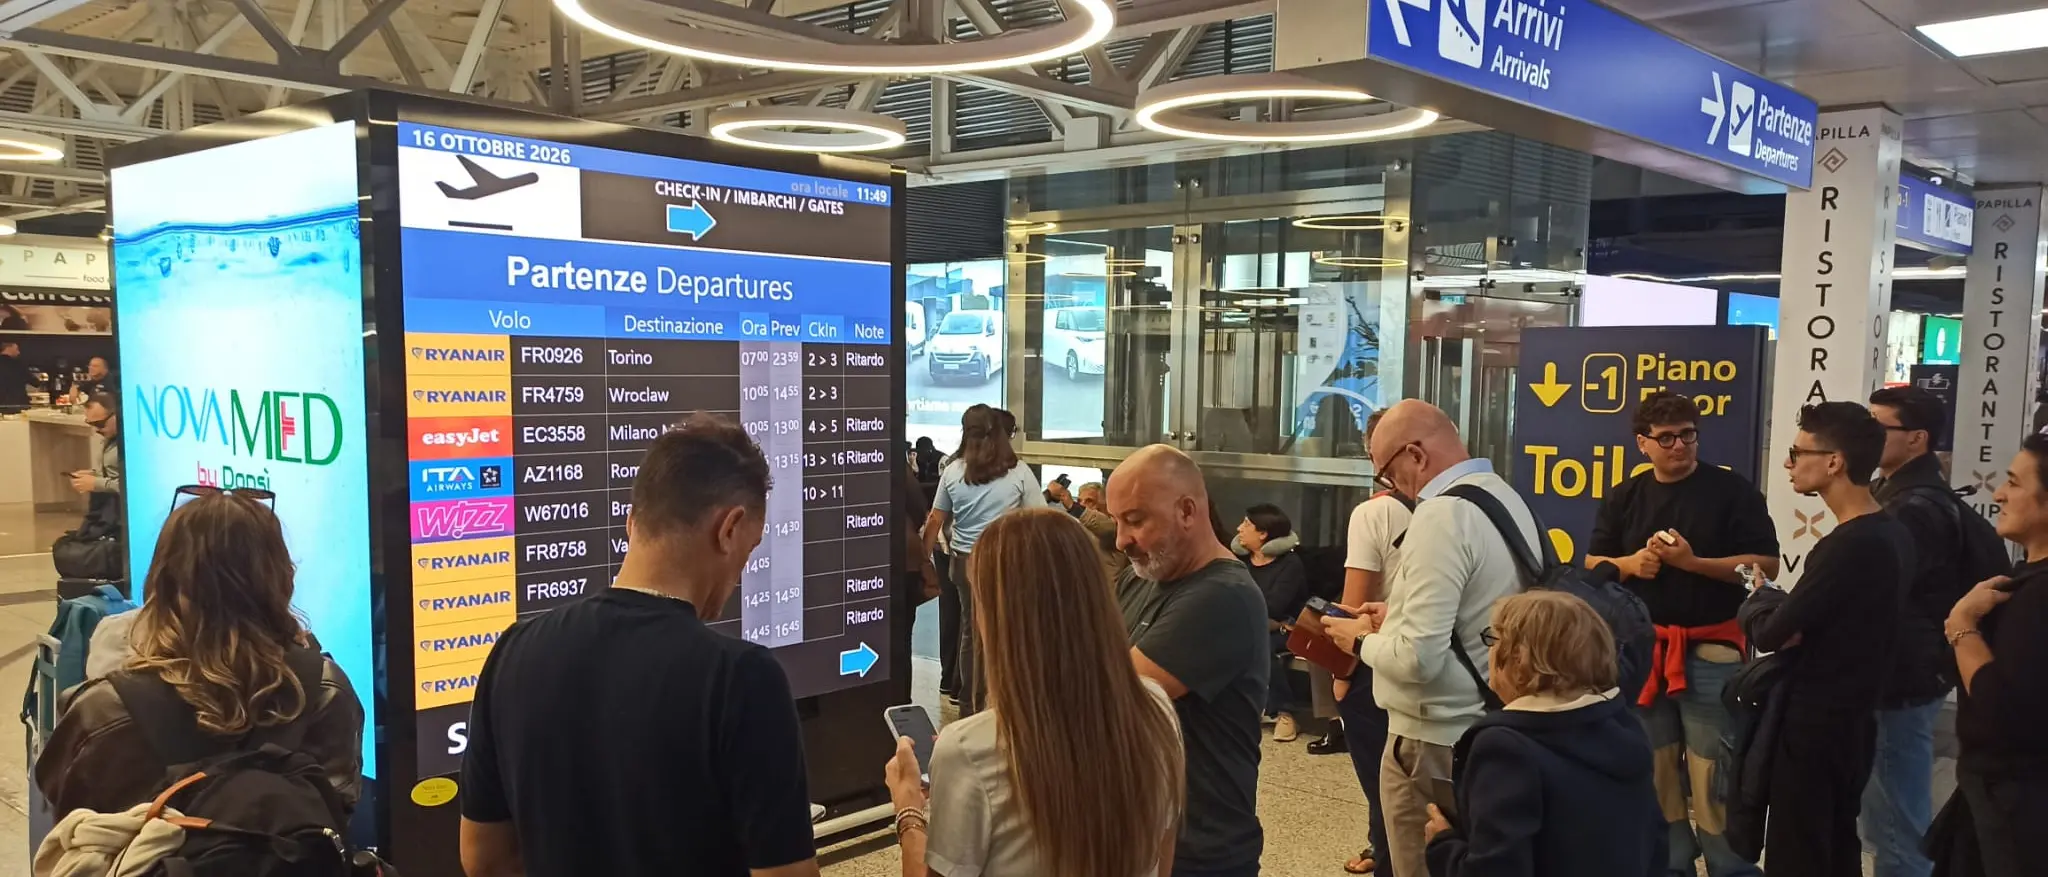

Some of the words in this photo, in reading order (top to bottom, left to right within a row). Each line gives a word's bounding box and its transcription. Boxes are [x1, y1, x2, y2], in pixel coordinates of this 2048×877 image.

[1493, 0, 1565, 51] Arrivi
[1490, 45, 1551, 90] Arrivals
[1757, 94, 1812, 147] Partenze
[1815, 125, 1870, 140] PILLA
[413, 129, 435, 147] 16
[440, 133, 525, 159] OTTOBRE
[530, 145, 571, 164] 2026
[1754, 138, 1799, 172] Departures
[655, 180, 721, 202] CHECK-IN
[734, 190, 797, 211] IMBARCHI
[808, 199, 844, 215] GATES
[791, 181, 810, 194] ora
[814, 180, 849, 199] locale
[856, 187, 888, 203] 11:49
[1977, 198, 2033, 210] PAPILLA
[23, 249, 96, 265] PAP
[507, 255, 647, 293] Partenze
[657, 266, 793, 303] Departures
[1806, 186, 1839, 402] RISTORA
[1871, 186, 1891, 394] RISTORA
[489, 309, 531, 329] Volo
[624, 315, 724, 335] Destinazione
[742, 320, 767, 337] Ora
[771, 320, 800, 337] Prev
[854, 324, 885, 340] Note
[425, 349, 505, 361] RYANAIR
[521, 346, 583, 364] FR0926
[608, 349, 653, 365] Torino
[808, 353, 816, 366] 2
[830, 353, 838, 366] 3
[846, 352, 884, 366] Ritardo
[1636, 352, 1737, 381] Piano
[1979, 242, 2009, 463] RISTORANTE
[427, 390, 506, 403] RYANAIR
[522, 387, 584, 404] FR4759
[608, 386, 669, 403] Wroclaw
[808, 386, 816, 400] 2
[830, 386, 838, 400] 3
[1586, 366, 1618, 400] -1
[422, 428, 500, 447] easyJet
[523, 425, 586, 443] EC3558
[610, 425, 658, 440] Milano
[808, 420, 816, 433] 4
[830, 420, 838, 433] 5
[846, 417, 884, 432] Ritardo
[197, 461, 217, 488] by
[422, 466, 476, 483] ITA
[524, 464, 584, 483] AZ1168
[803, 453, 816, 467] 13
[831, 452, 845, 466] 16
[846, 449, 884, 464] Ritardo
[1524, 445, 1732, 498] Toil
[427, 482, 473, 492] AIRWAYS
[524, 502, 589, 522] W67016
[803, 487, 817, 501] 10
[831, 484, 844, 499] 11
[431, 551, 510, 569] RYANAIR
[526, 540, 587, 562] FR8758
[846, 513, 884, 529] Ritardo
[432, 591, 511, 610] RYANAIR
[527, 578, 588, 601] FR6937
[433, 631, 503, 651] RYANAI
[846, 576, 884, 594] Ritardo
[434, 675, 480, 692] RYAN
[846, 607, 884, 626] Ritardo
